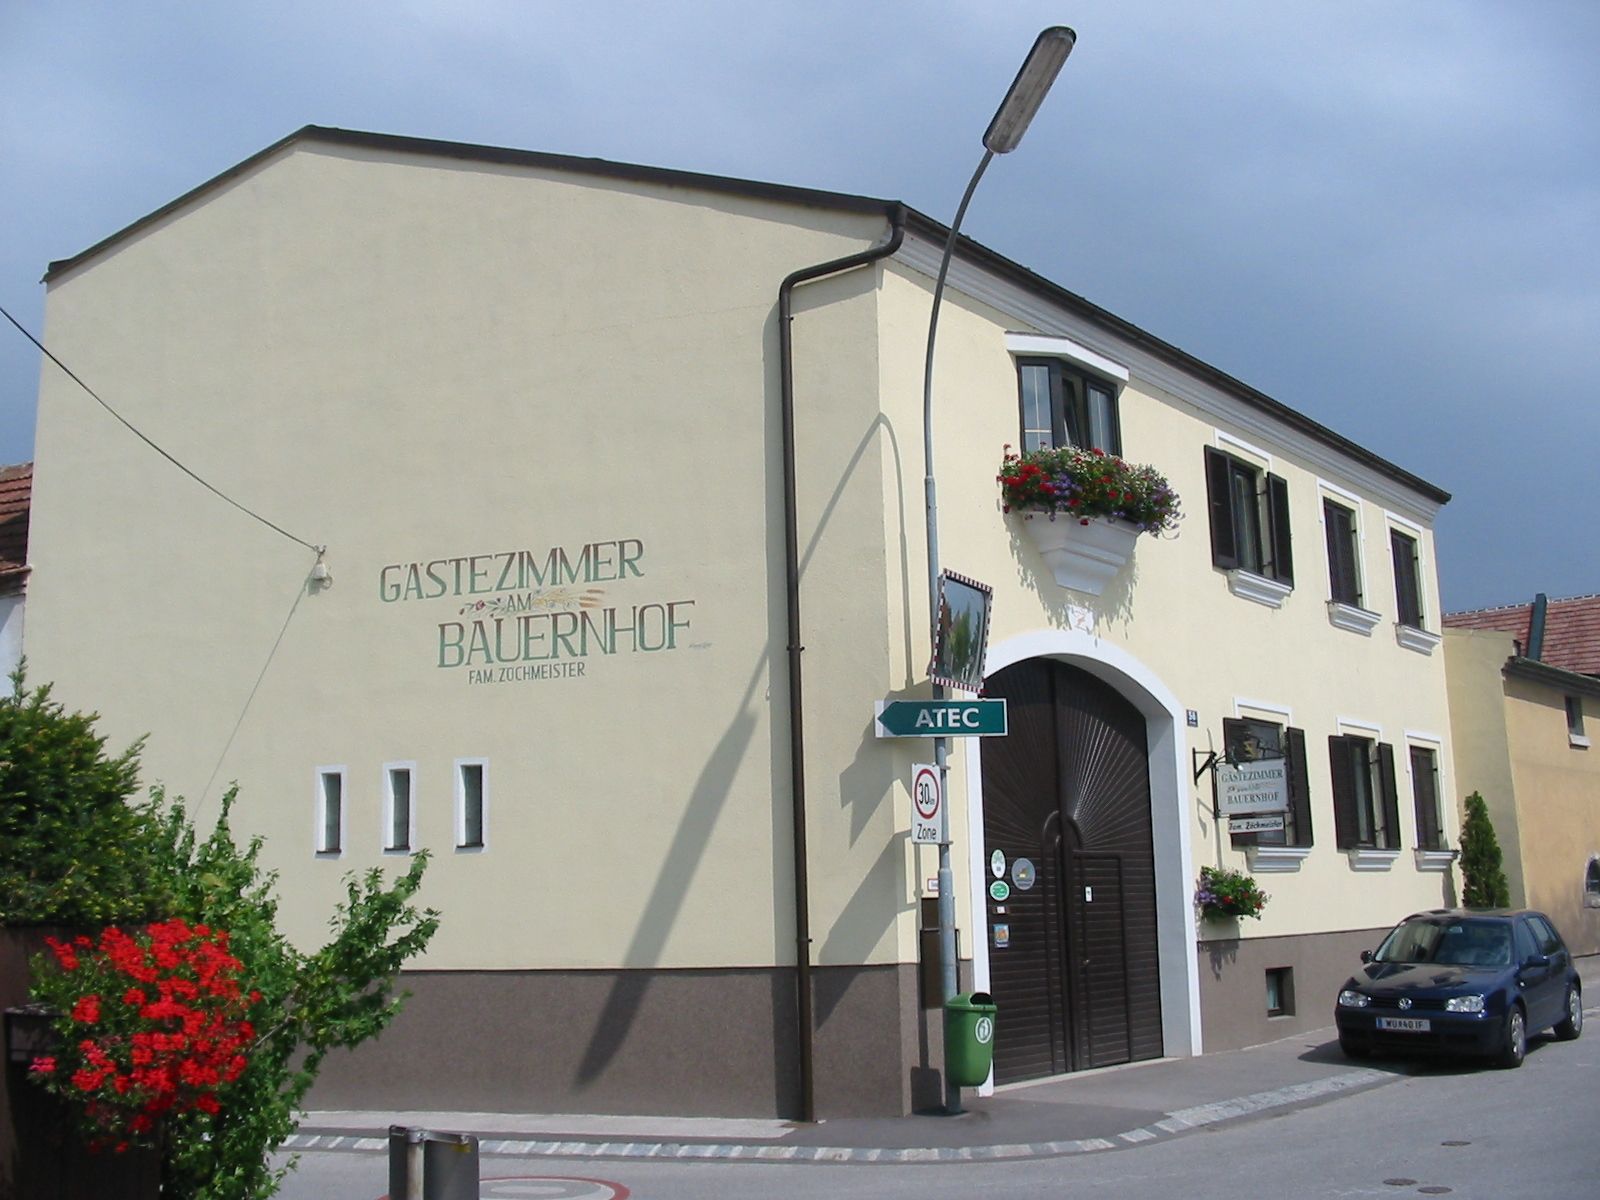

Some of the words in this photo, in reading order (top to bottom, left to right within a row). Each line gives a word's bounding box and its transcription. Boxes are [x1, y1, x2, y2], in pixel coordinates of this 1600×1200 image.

[380, 539, 645, 603] GÄSTEZIMMER
[506, 593, 533, 612] AM
[437, 600, 695, 668] BAUERNHOF
[468, 669, 496, 685] FAM.
[915, 707, 980, 728] ATEC
[918, 783, 930, 805] 30
[1227, 791, 1280, 805] BAUERNHOF
[917, 823, 937, 840] Zone
